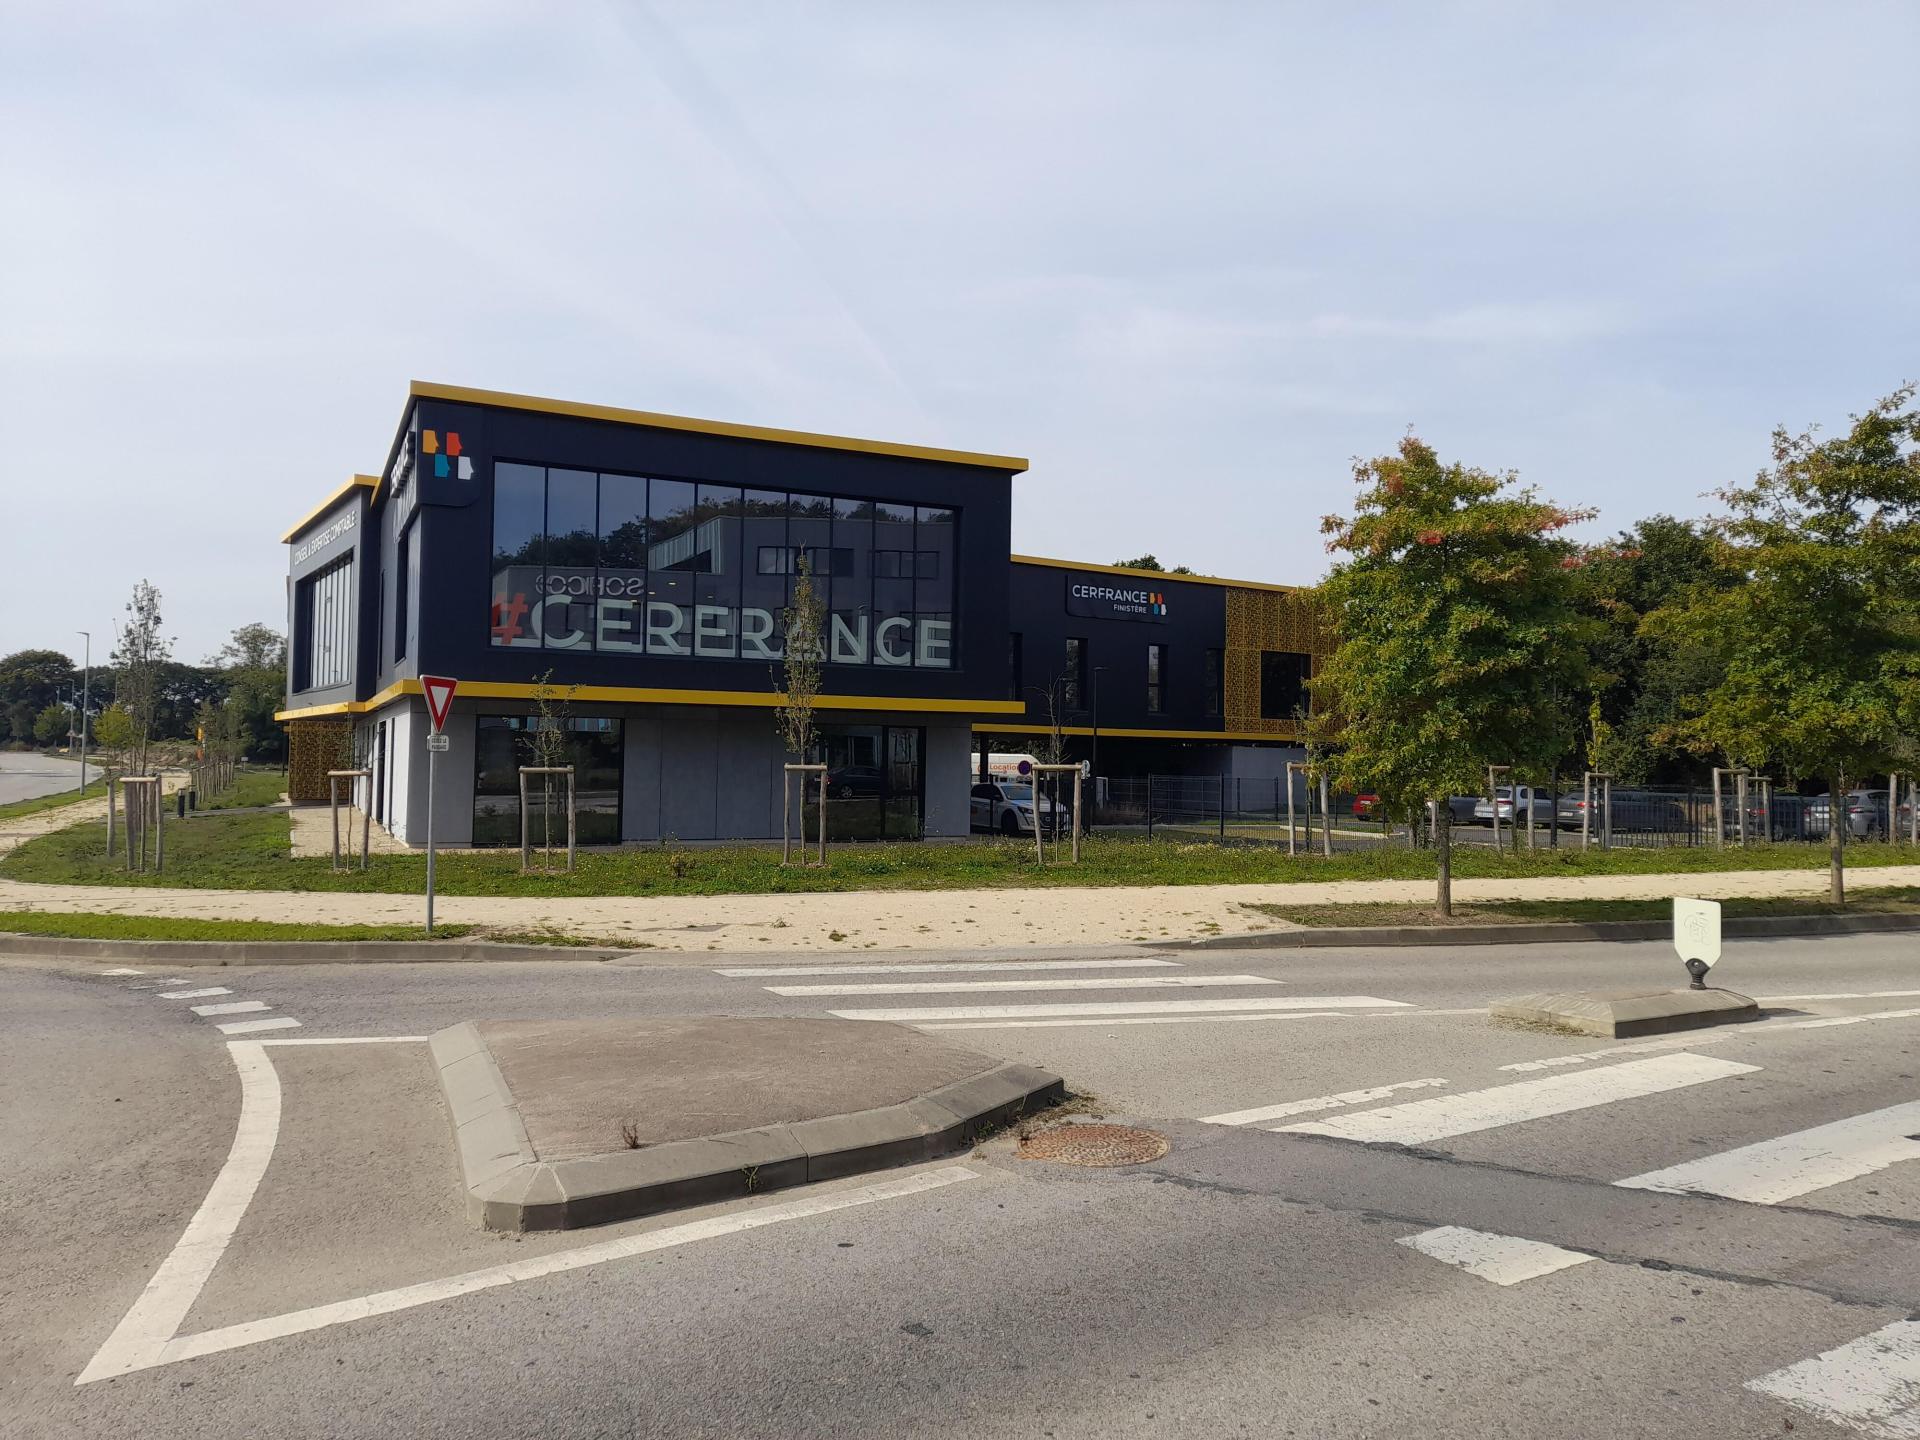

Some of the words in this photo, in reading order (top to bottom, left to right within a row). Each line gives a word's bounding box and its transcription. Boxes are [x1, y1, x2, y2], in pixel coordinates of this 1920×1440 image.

[1072, 584, 1148, 604] CERFRANCE
[1113, 603, 1147, 614] FINISTÈRE
[989, 762, 1019, 772] Locatio
